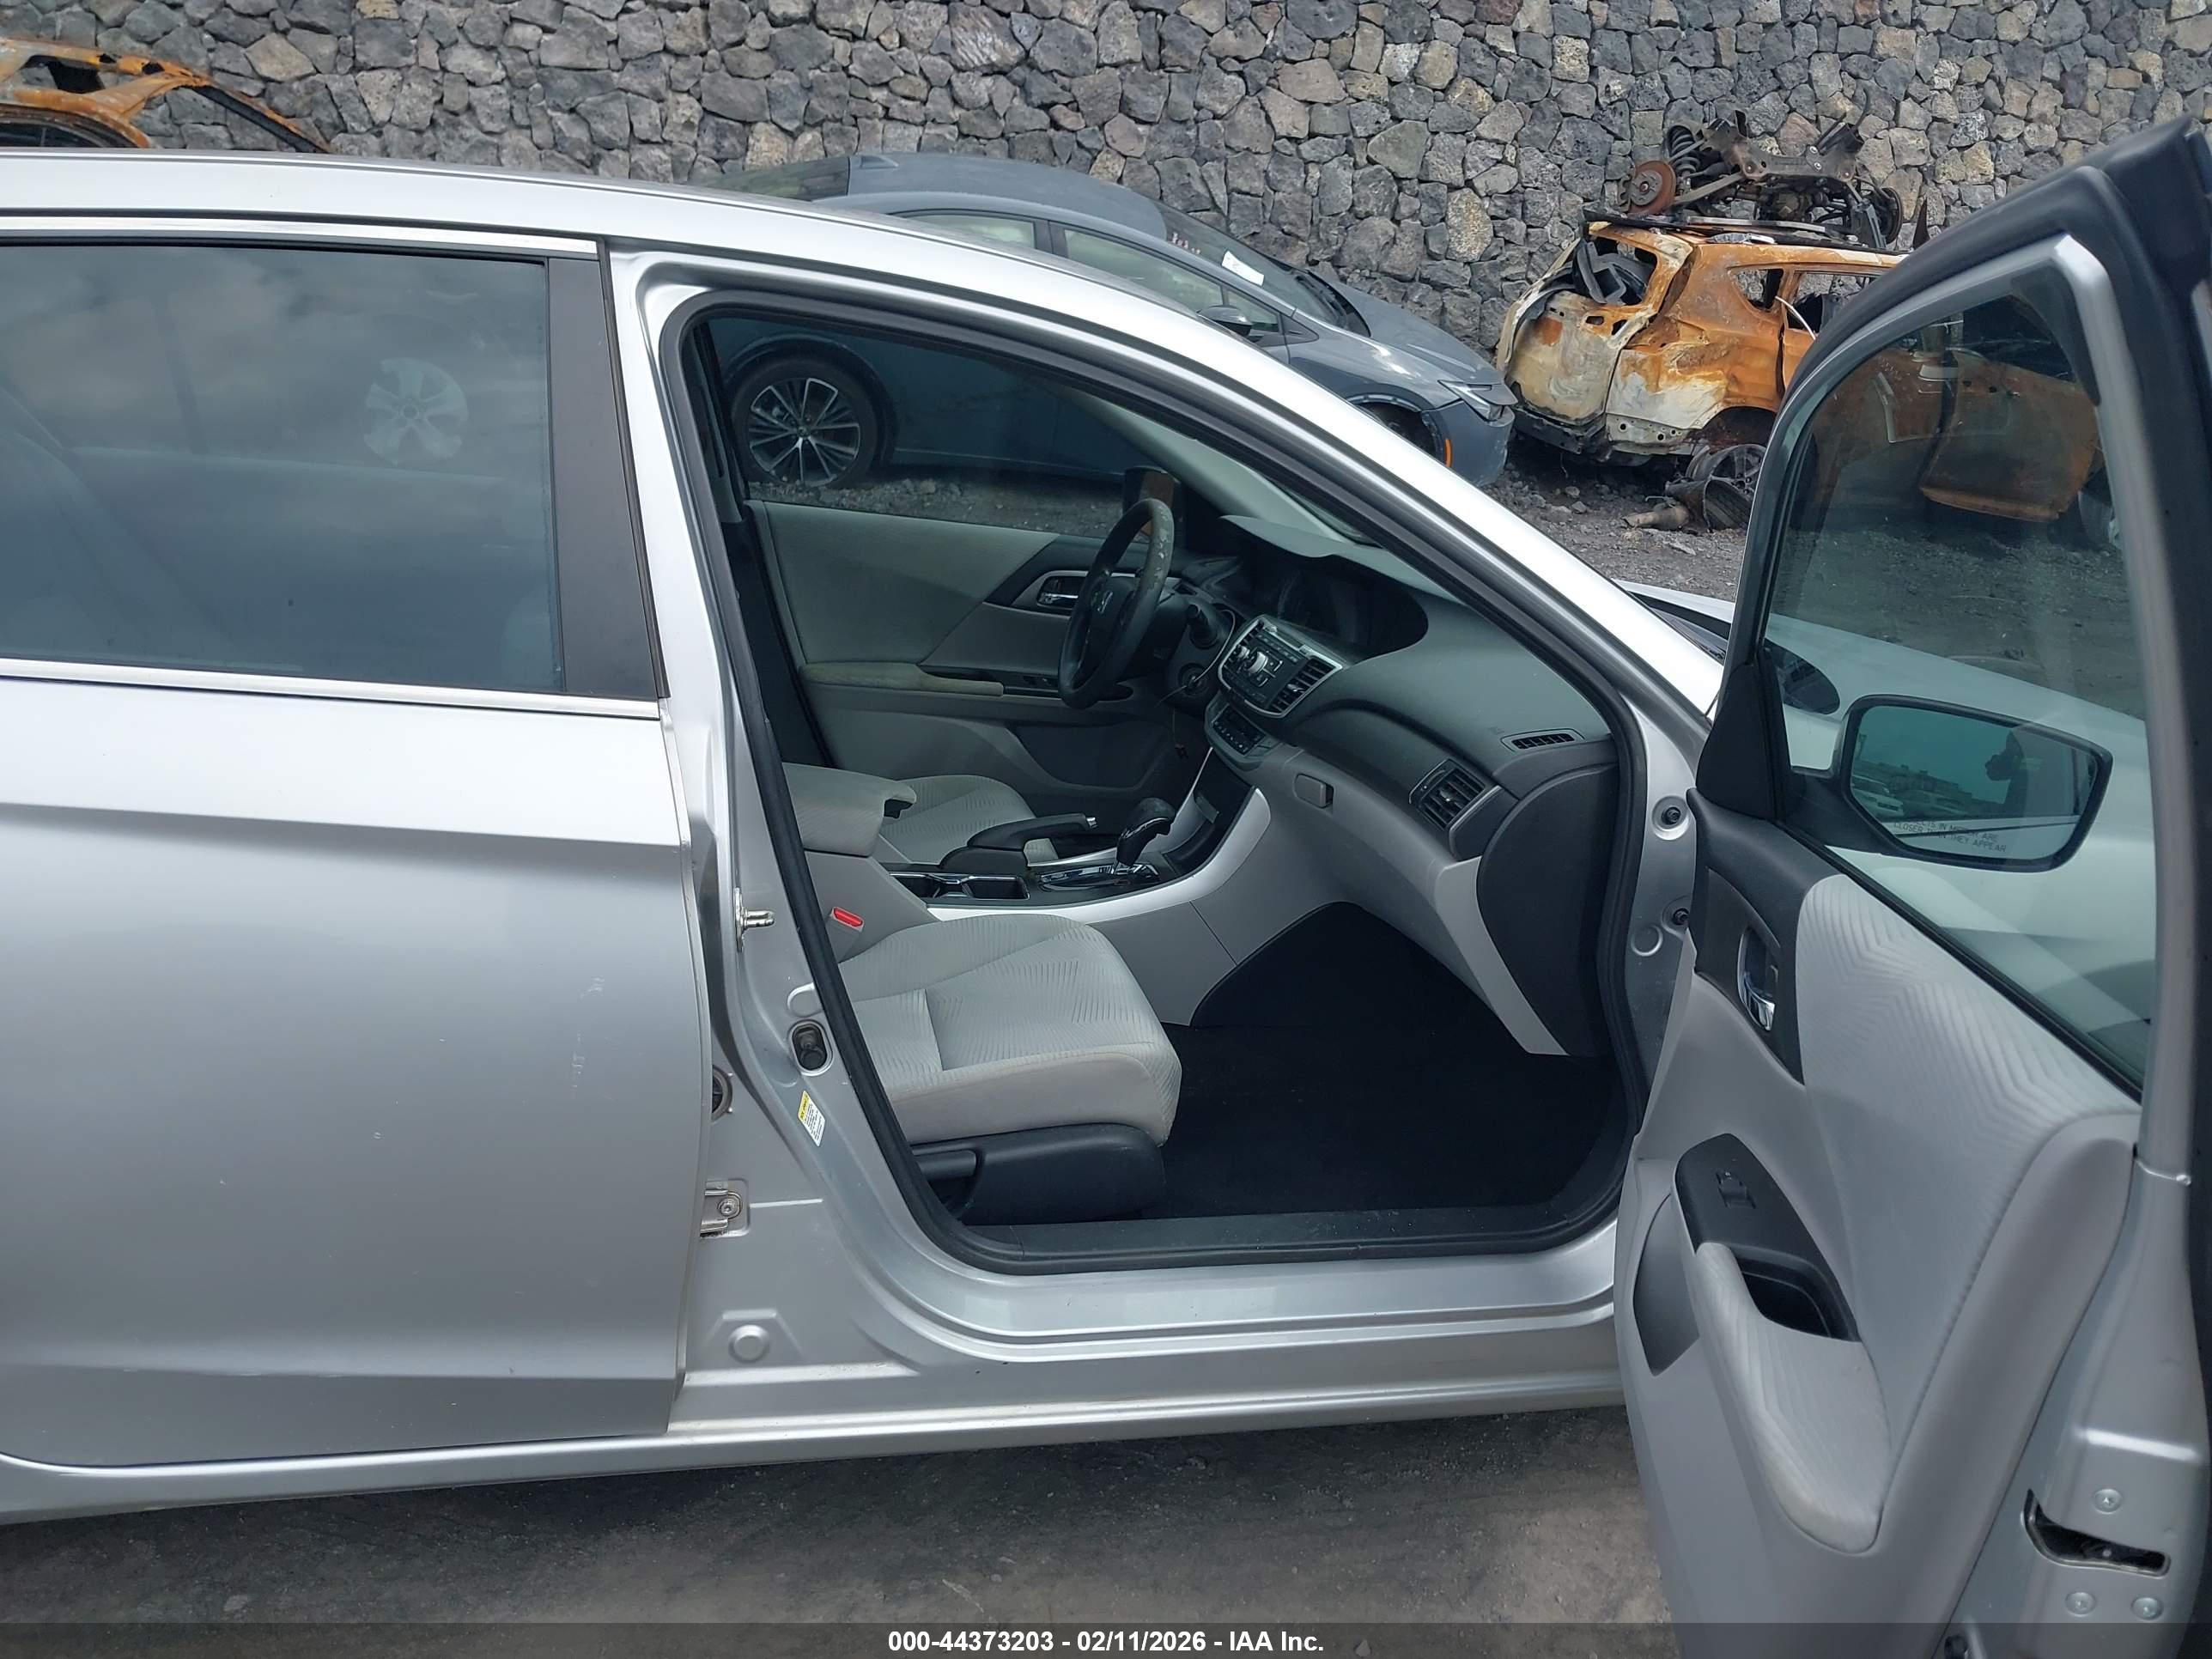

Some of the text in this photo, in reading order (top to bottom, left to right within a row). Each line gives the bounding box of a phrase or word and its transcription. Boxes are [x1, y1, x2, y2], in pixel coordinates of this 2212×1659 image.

[1893, 822, 1923, 833] CLOSER
[1972, 839, 2007, 853] APPEAR
[1982, 833, 1999, 843] ARE
